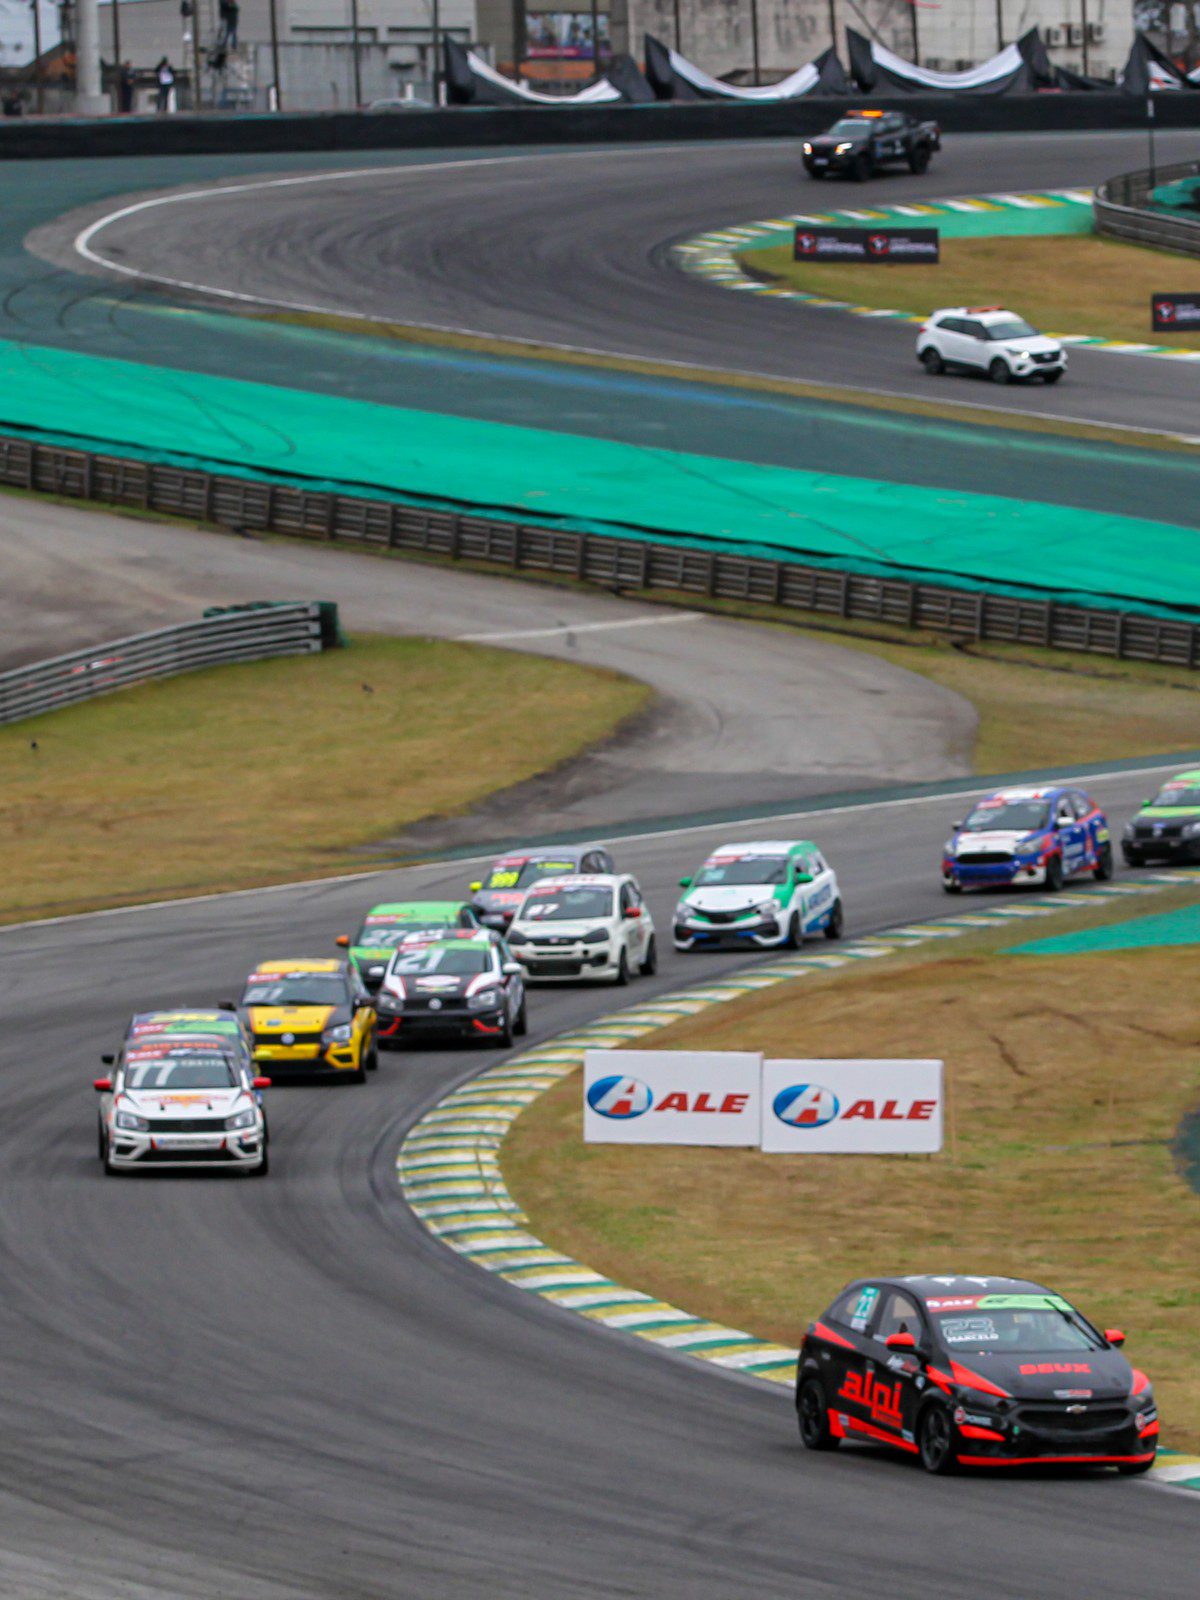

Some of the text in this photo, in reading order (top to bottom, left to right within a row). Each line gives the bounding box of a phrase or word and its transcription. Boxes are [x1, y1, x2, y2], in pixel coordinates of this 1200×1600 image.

[127, 1060, 177, 1088] 77
[654, 1092, 750, 1114] ALE
[840, 1099, 937, 1121] ALE
[838, 1369, 903, 1420] alpi
